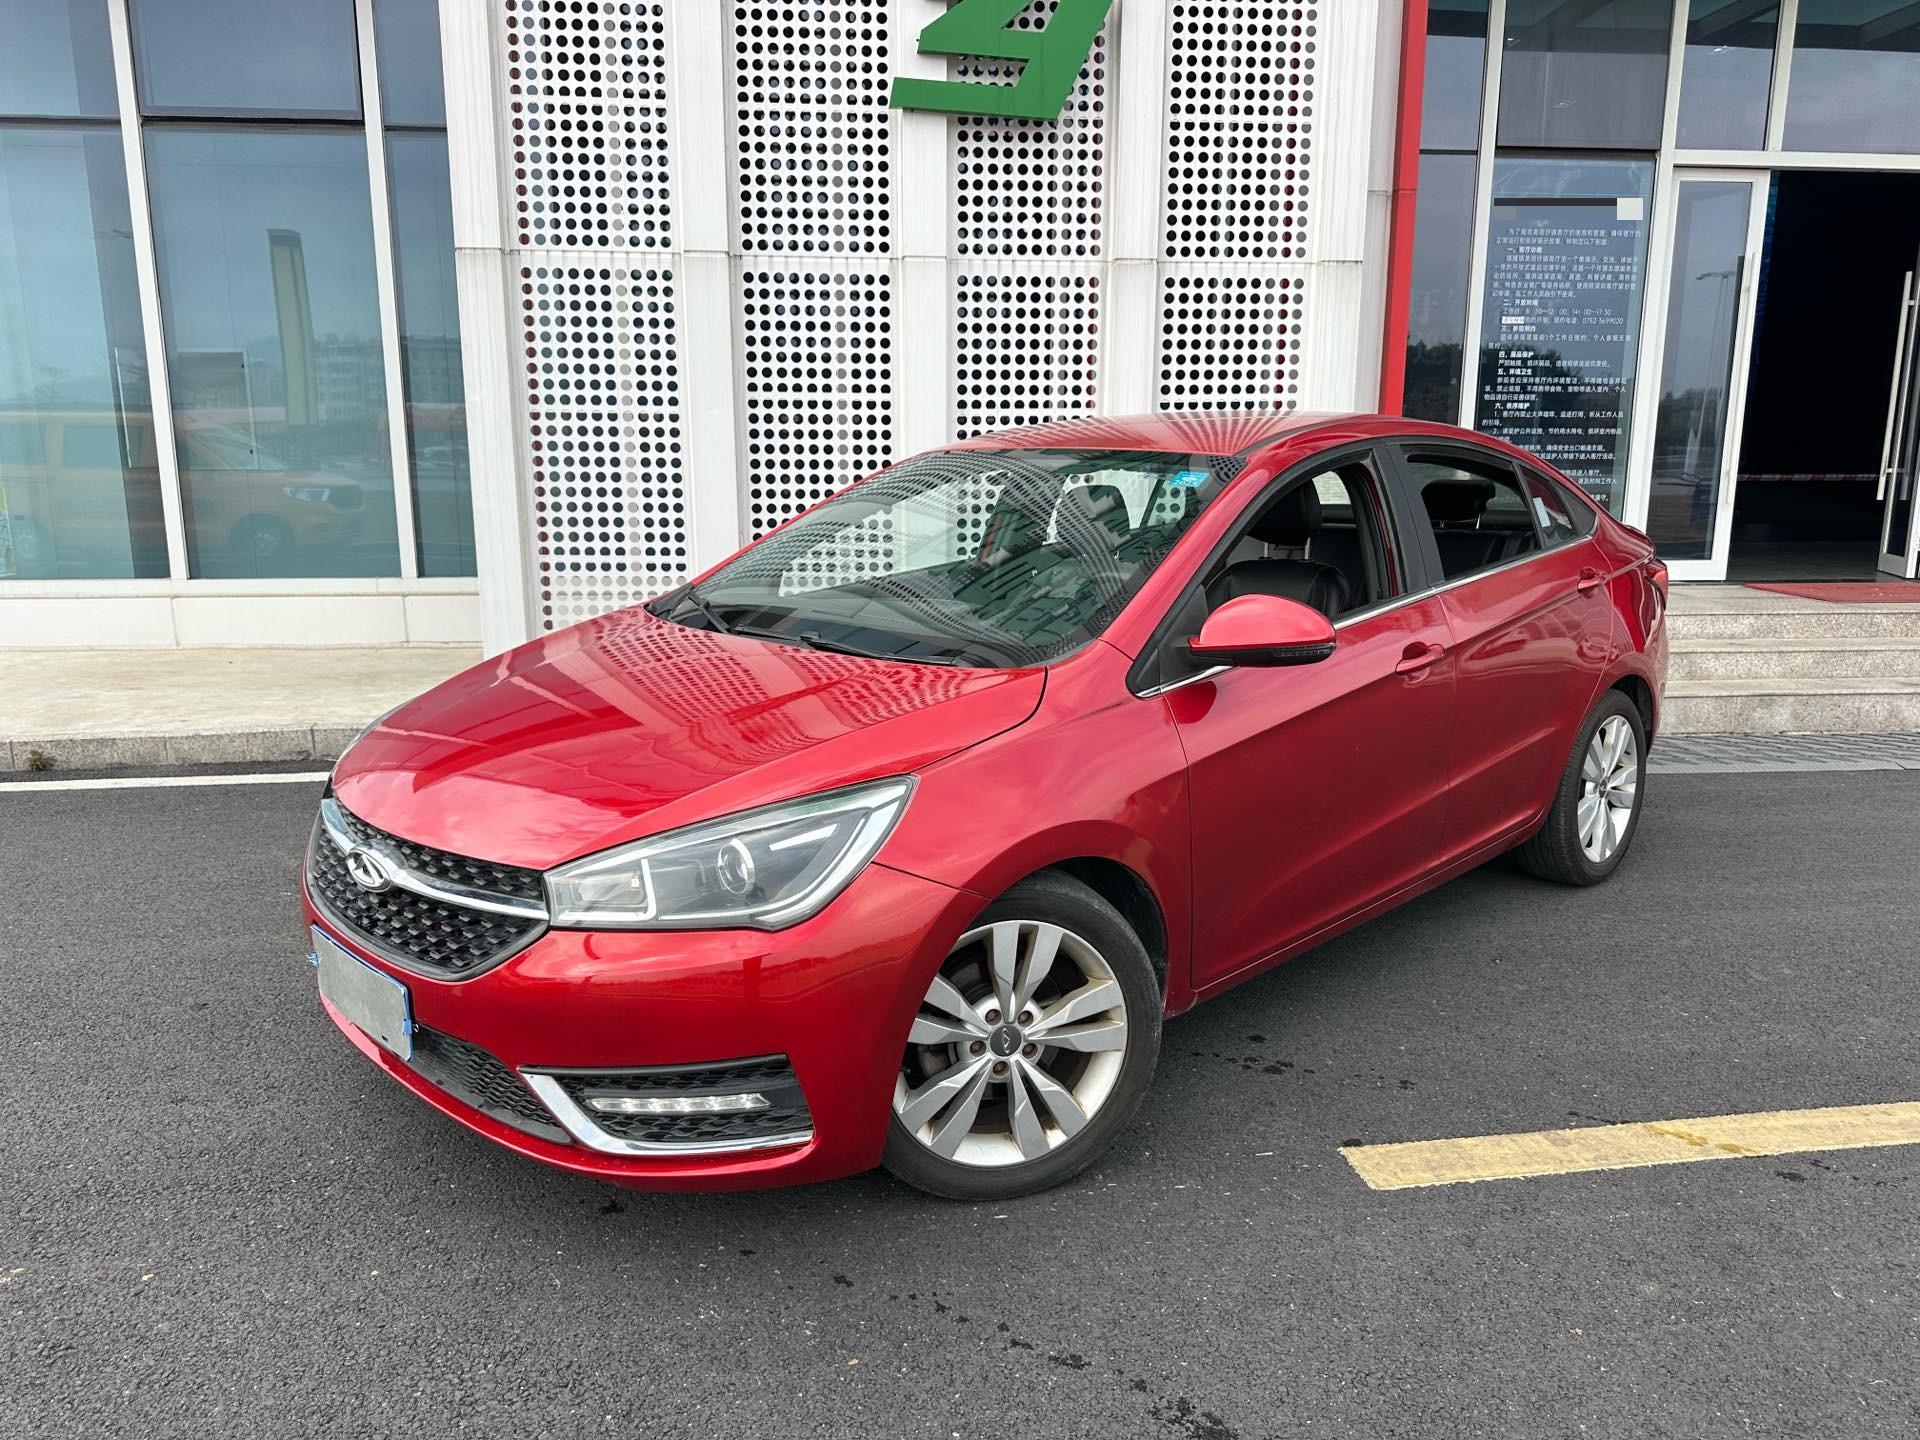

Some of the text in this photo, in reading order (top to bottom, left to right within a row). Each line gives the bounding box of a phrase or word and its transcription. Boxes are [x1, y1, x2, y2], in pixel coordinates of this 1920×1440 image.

[1497, 368, 1532, 376] 五、环境卫生
[1495, 402, 1530, 410] 六、秩序维护
